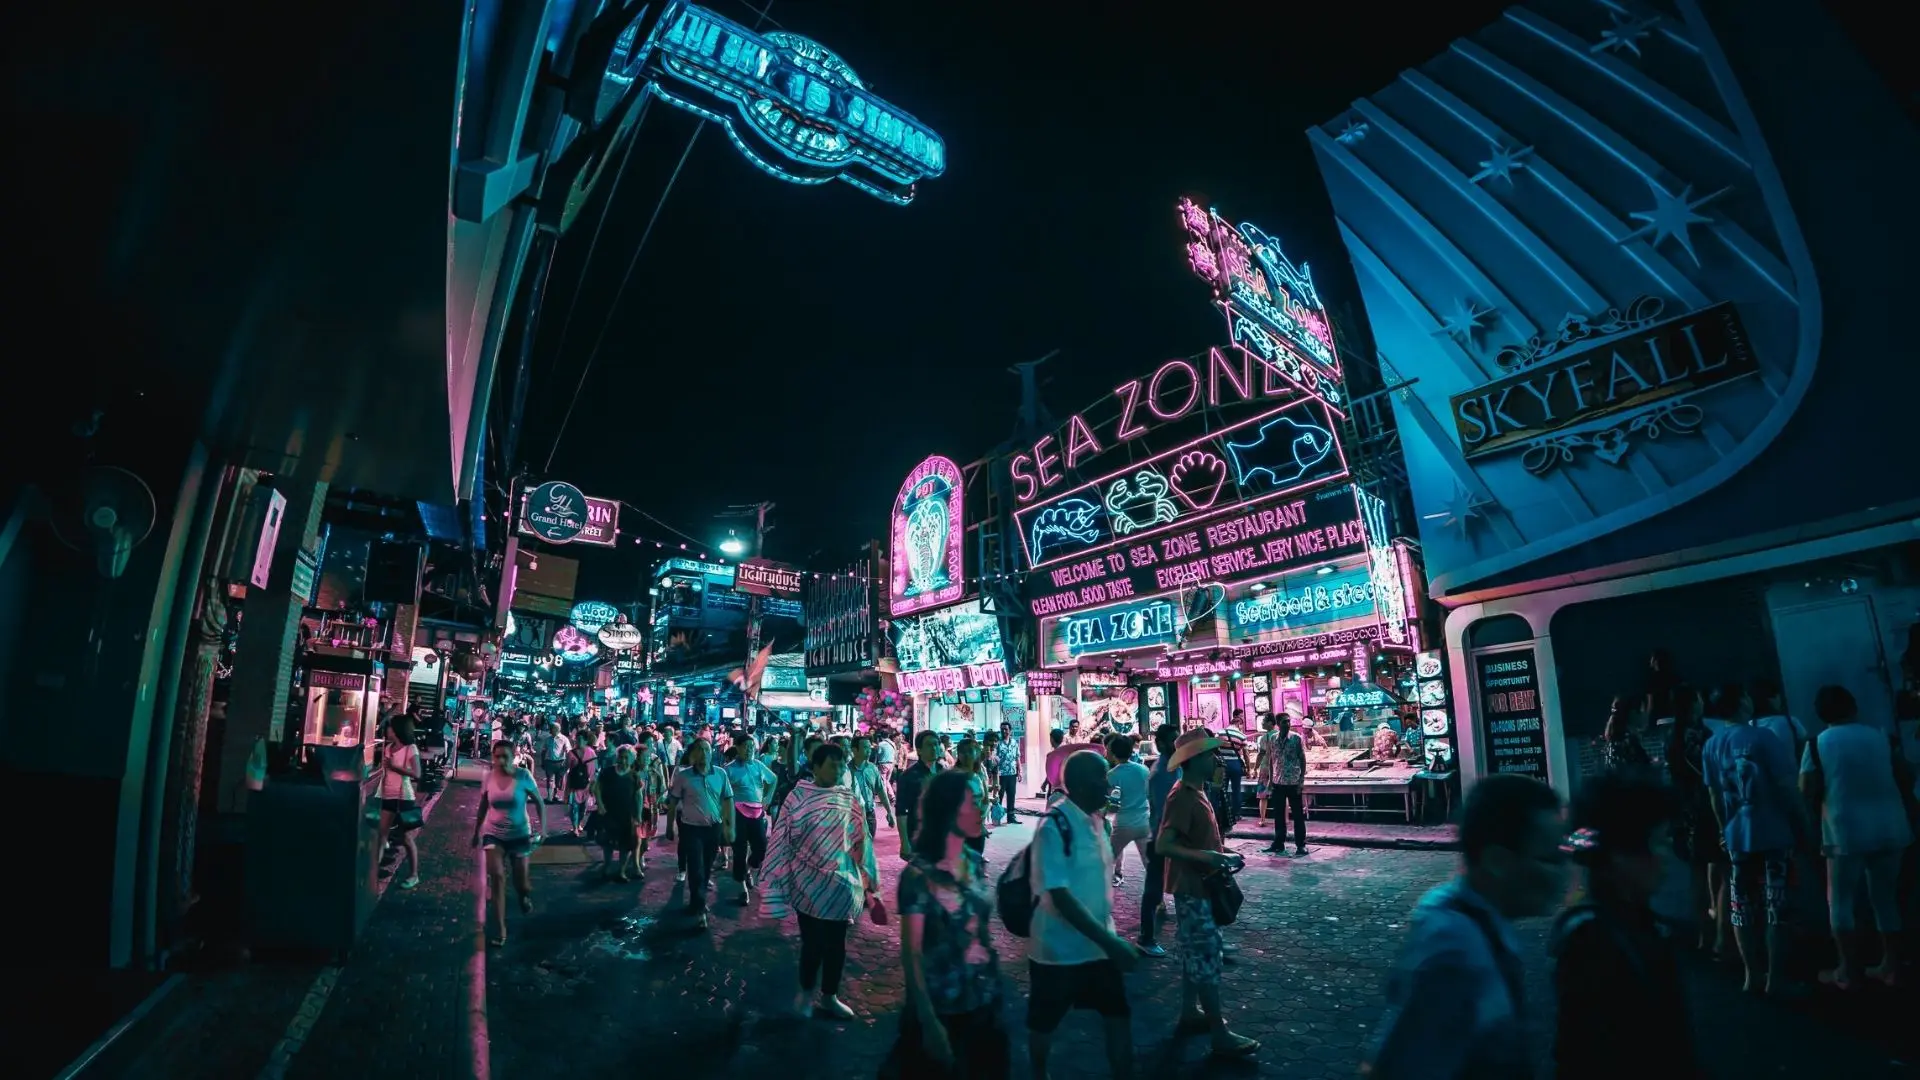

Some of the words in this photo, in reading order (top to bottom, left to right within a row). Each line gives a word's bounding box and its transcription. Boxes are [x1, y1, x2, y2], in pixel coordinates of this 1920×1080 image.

[1227, 247, 1271, 301] SEA
[1458, 324, 1727, 443] SKYFALL
[1011, 415, 1100, 500] SEA
[916, 481, 935, 498] POT
[530, 512, 557, 525] Grand
[1051, 558, 1107, 588] WELCOME
[1107, 553, 1125, 573] TO
[1130, 544, 1158, 567] SEA
[1161, 531, 1202, 560] ZONE
[1206, 500, 1307, 548] RESTAURANT
[739, 568, 800, 587] LIGHTHOUSE
[948, 549, 959, 581] FOOD
[1032, 595, 1057, 616] CLEAN
[1105, 577, 1135, 600] TASTE
[1156, 559, 1211, 588] EXCELLENT
[1295, 528, 1326, 556] NICE
[1235, 586, 1314, 625] Seafood
[1315, 585, 1332, 611] &
[1332, 581, 1376, 609] stea
[603, 629, 639, 639] SIMON
[1067, 617, 1106, 647] SEA
[1110, 604, 1173, 641] ZONE
[806, 639, 868, 668] IGHTHOUSE
[1485, 660, 1529, 673] BUSINESS
[313, 673, 361, 688] POPCORN
[899, 668, 965, 693] LOBSTER
[967, 661, 1008, 687] POT
[1486, 675, 1531, 688] OPPORTUNITY
[1488, 692, 1508, 713] FOR
[1508, 689, 1535, 712] RENT
